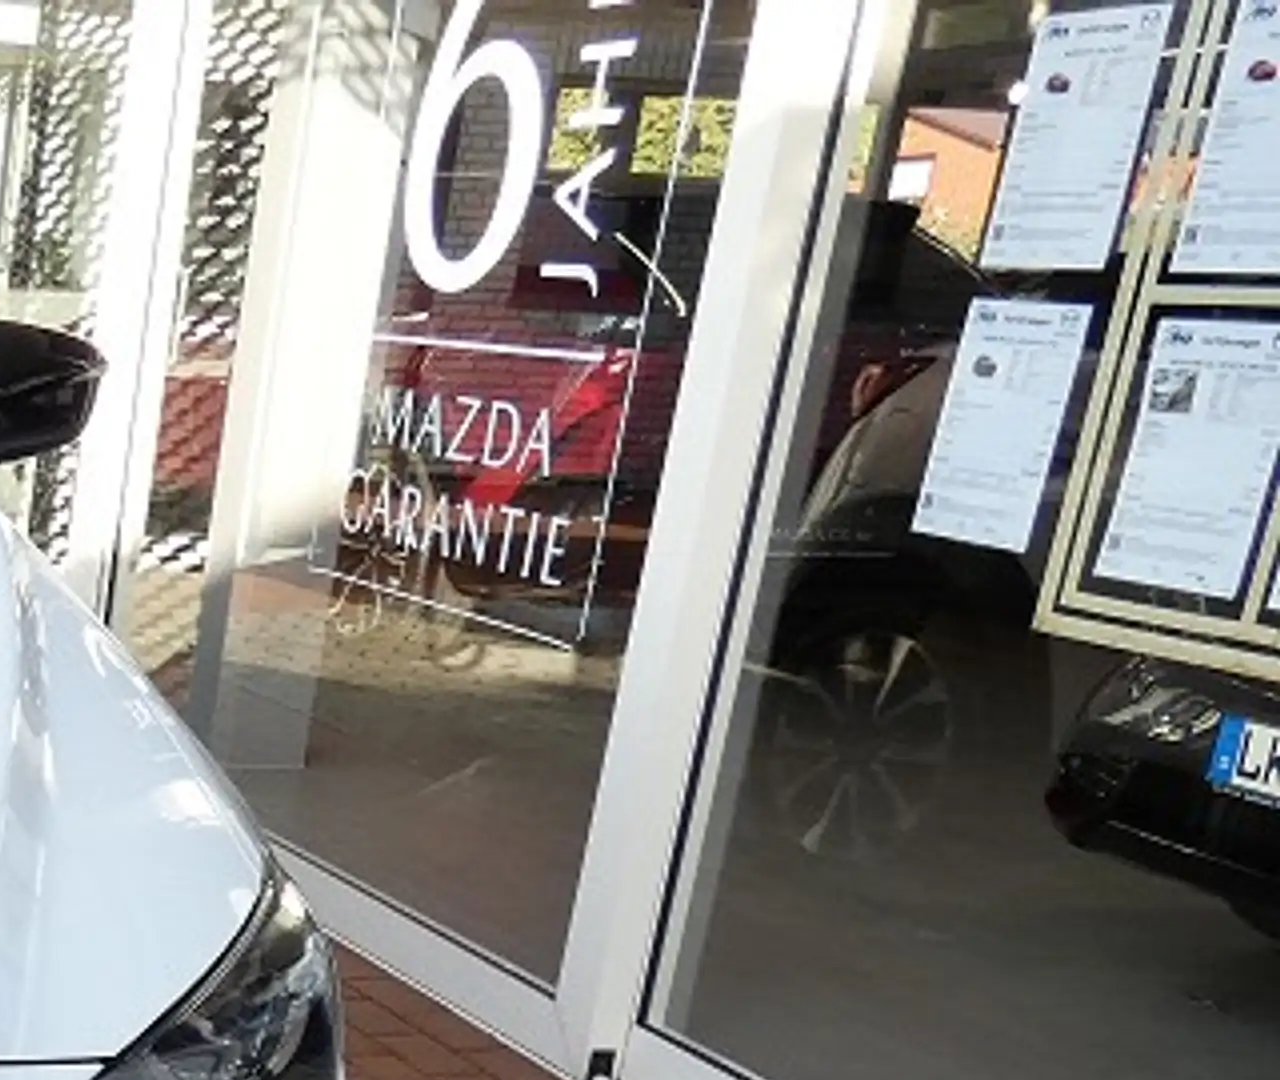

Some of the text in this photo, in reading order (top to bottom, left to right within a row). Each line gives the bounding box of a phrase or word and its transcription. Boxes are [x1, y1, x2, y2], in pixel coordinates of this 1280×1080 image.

[404, 0, 541, 293] 6
[540, 0, 638, 298] JAH
[340, 468, 572, 586] GARANTIE
[372, 388, 551, 477] MAZDA
